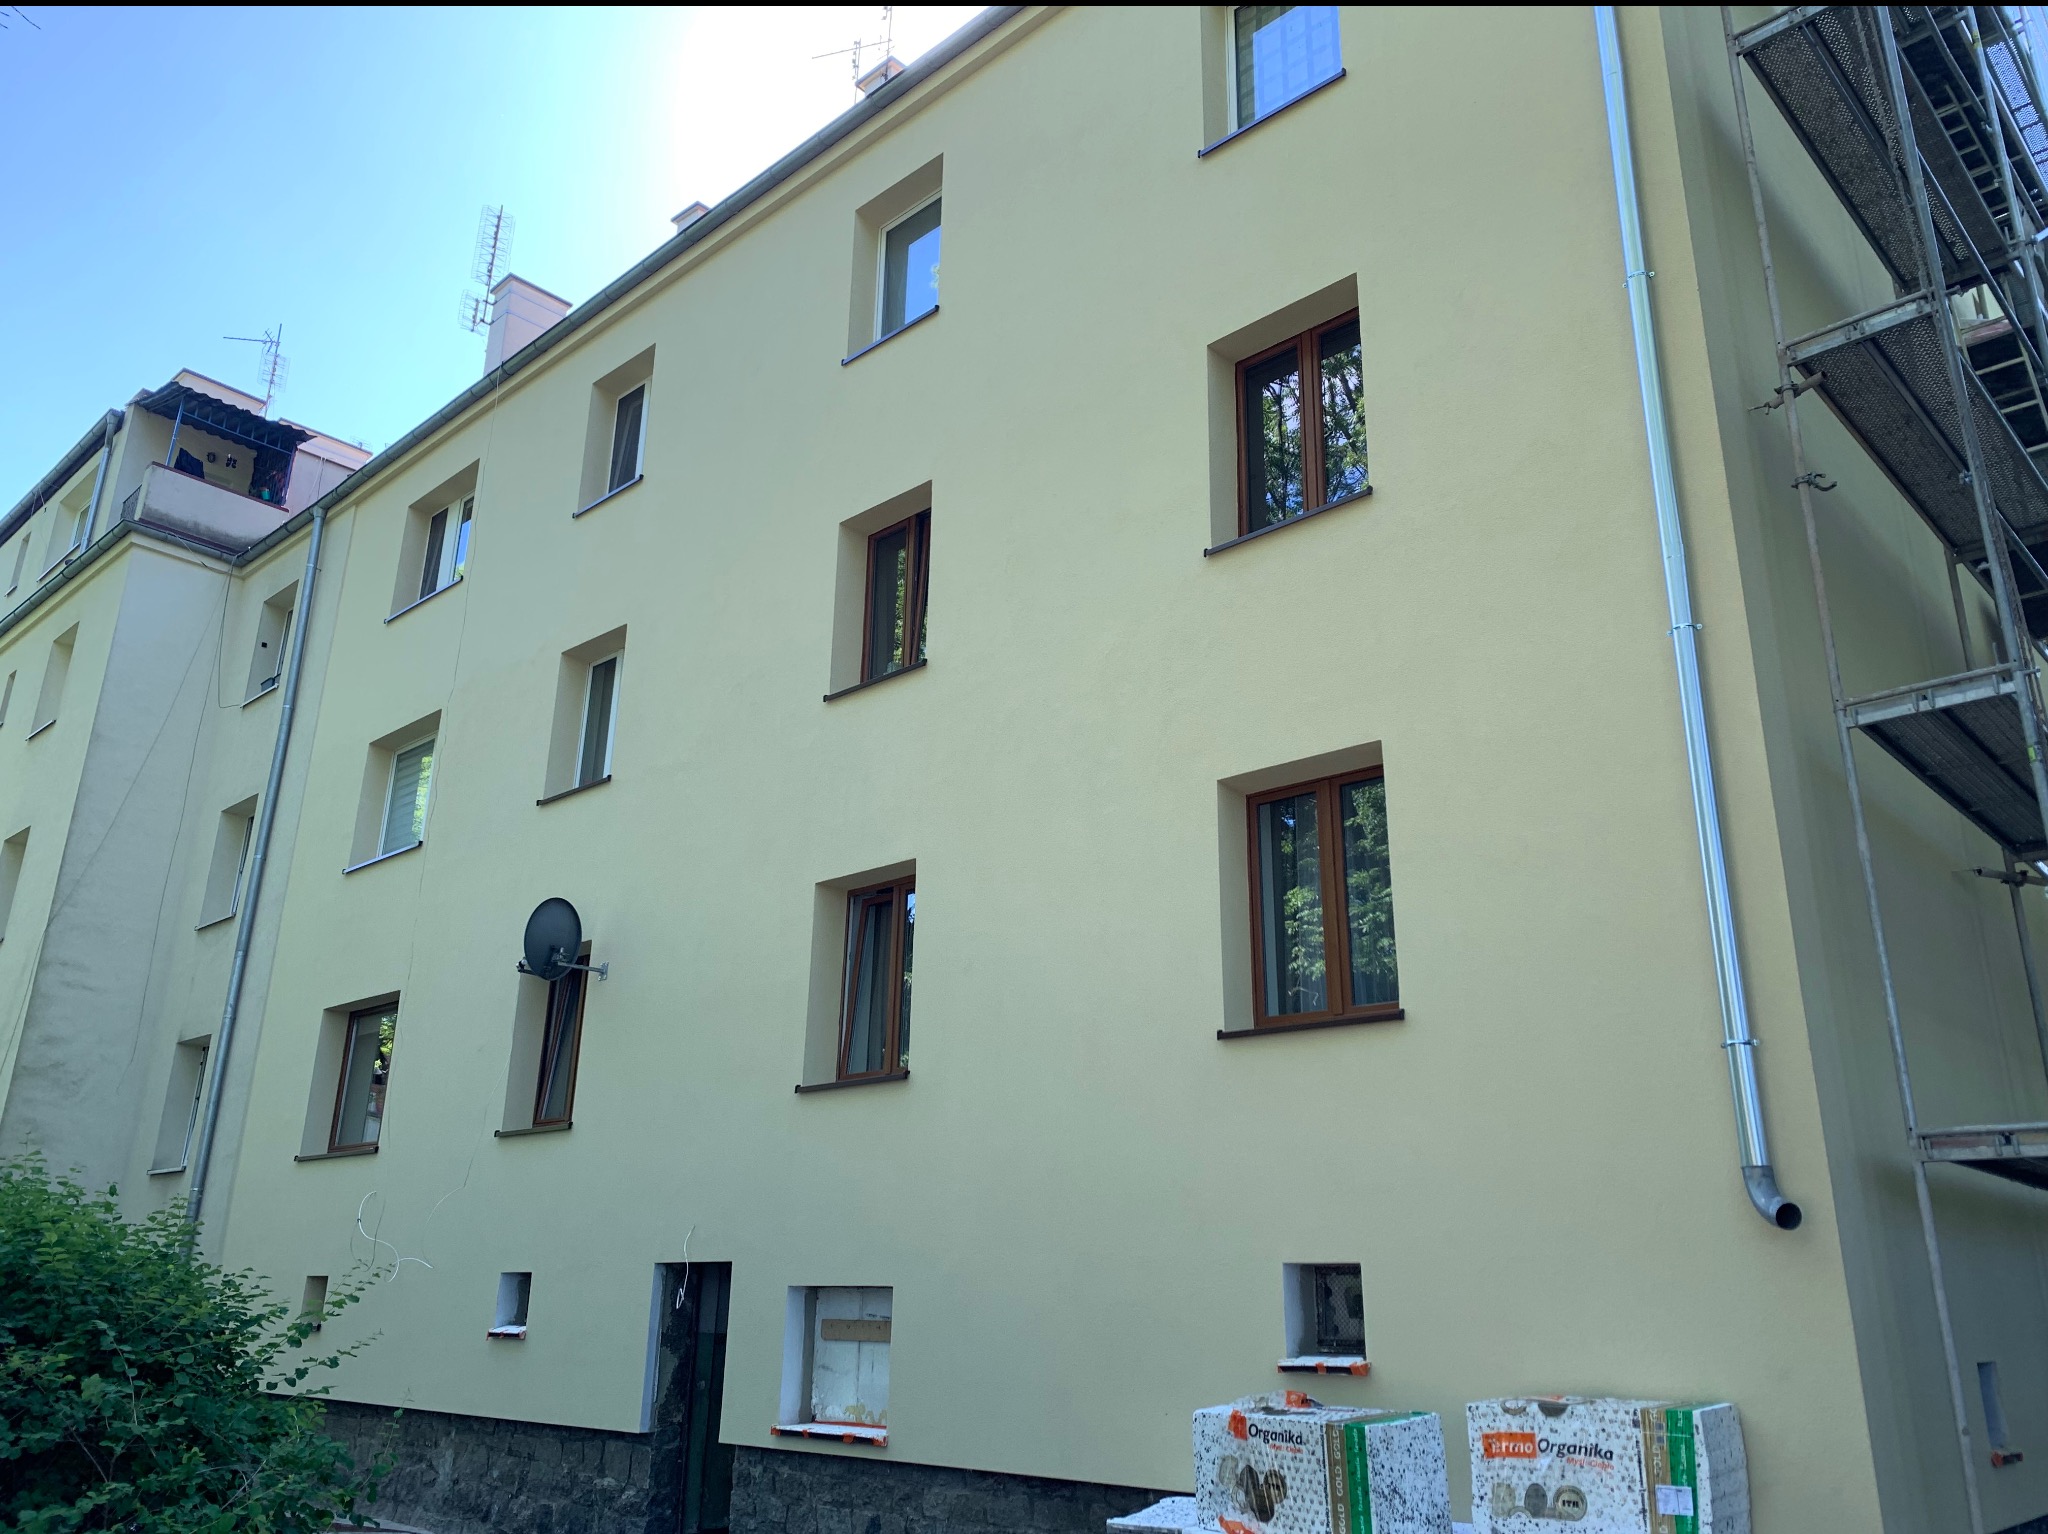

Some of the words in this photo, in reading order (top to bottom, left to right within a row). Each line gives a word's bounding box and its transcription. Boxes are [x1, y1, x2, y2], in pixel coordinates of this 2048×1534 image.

[1248, 1423, 1303, 1446] Organika
[1332, 1429, 1341, 1459] GOLD
[1537, 1438, 1614, 1461] Organika
[1335, 1466, 1344, 1496] GOLD
